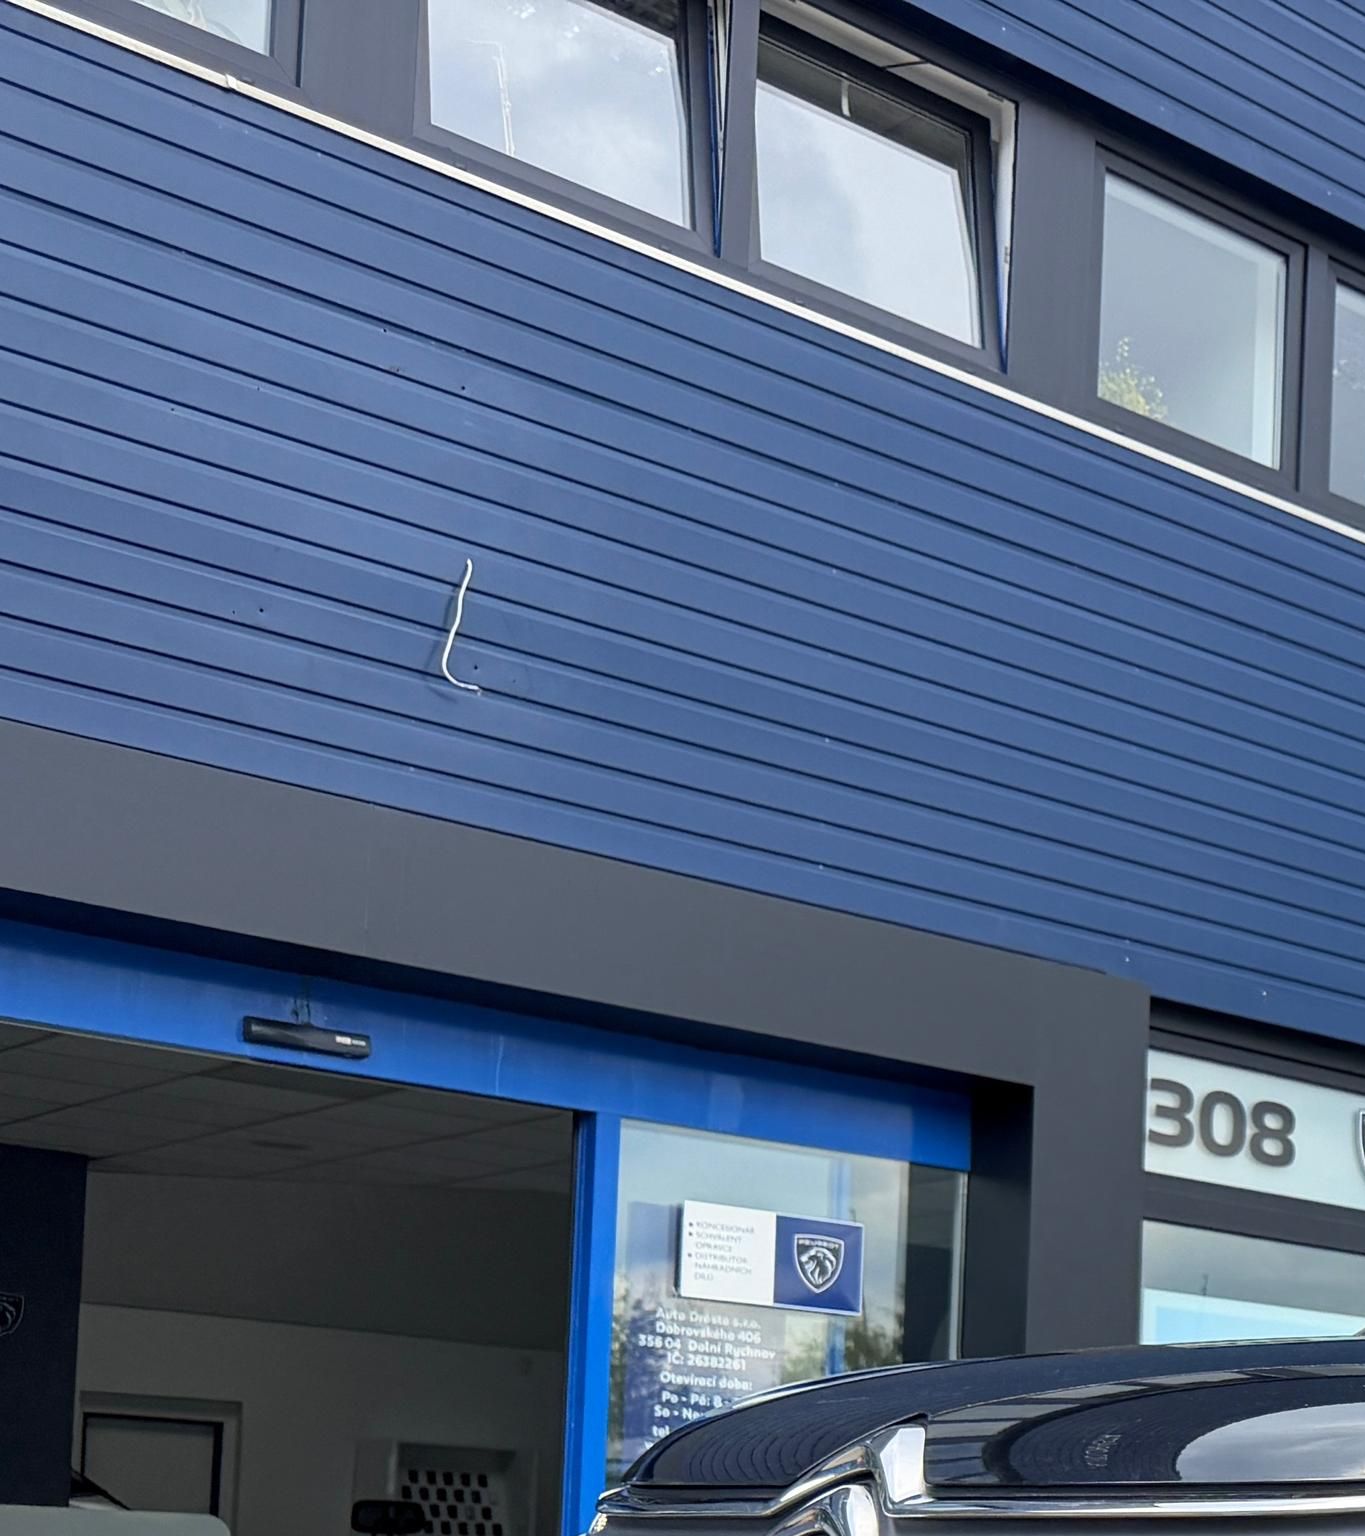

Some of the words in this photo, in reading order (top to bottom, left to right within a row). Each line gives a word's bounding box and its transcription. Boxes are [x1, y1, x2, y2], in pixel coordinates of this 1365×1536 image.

[1148, 1077, 1297, 1167] 308
[655, 1306, 687, 1322] Auto
[737, 1330, 762, 1345] 406
[687, 1339, 721, 1354] Dolní
[724, 1342, 777, 1360] Rychnov
[719, 1375, 753, 1391] doba:
[661, 1390, 679, 1404] Po
[654, 1404, 671, 1418] So
